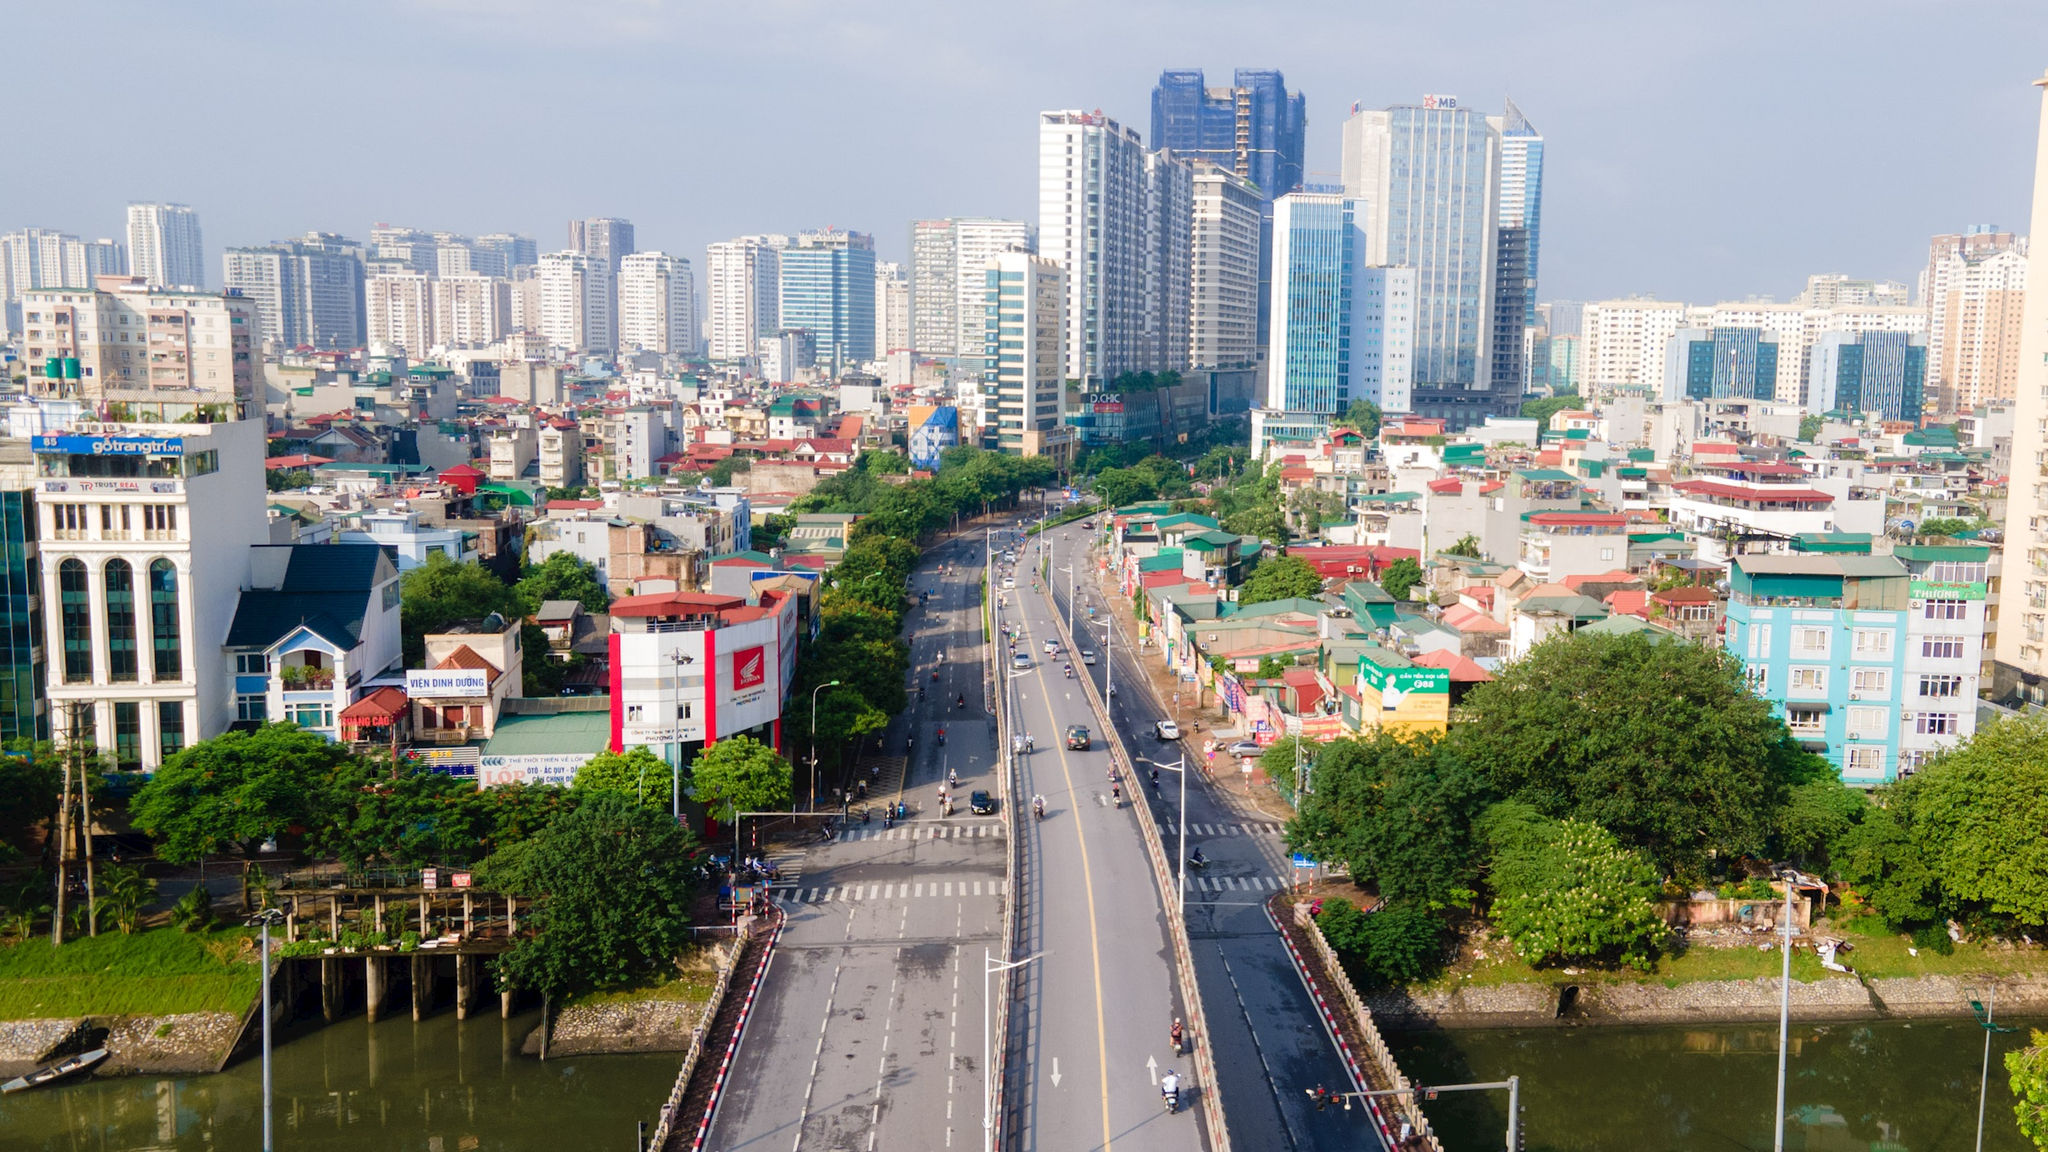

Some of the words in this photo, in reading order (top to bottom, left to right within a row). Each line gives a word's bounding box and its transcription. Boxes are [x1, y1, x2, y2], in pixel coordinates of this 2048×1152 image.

[1438, 97, 1457, 108] MB
[1090, 393, 1121, 403] D.CHIC
[410, 677, 430, 689] VIỆN
[432, 678, 453, 688] DINH
